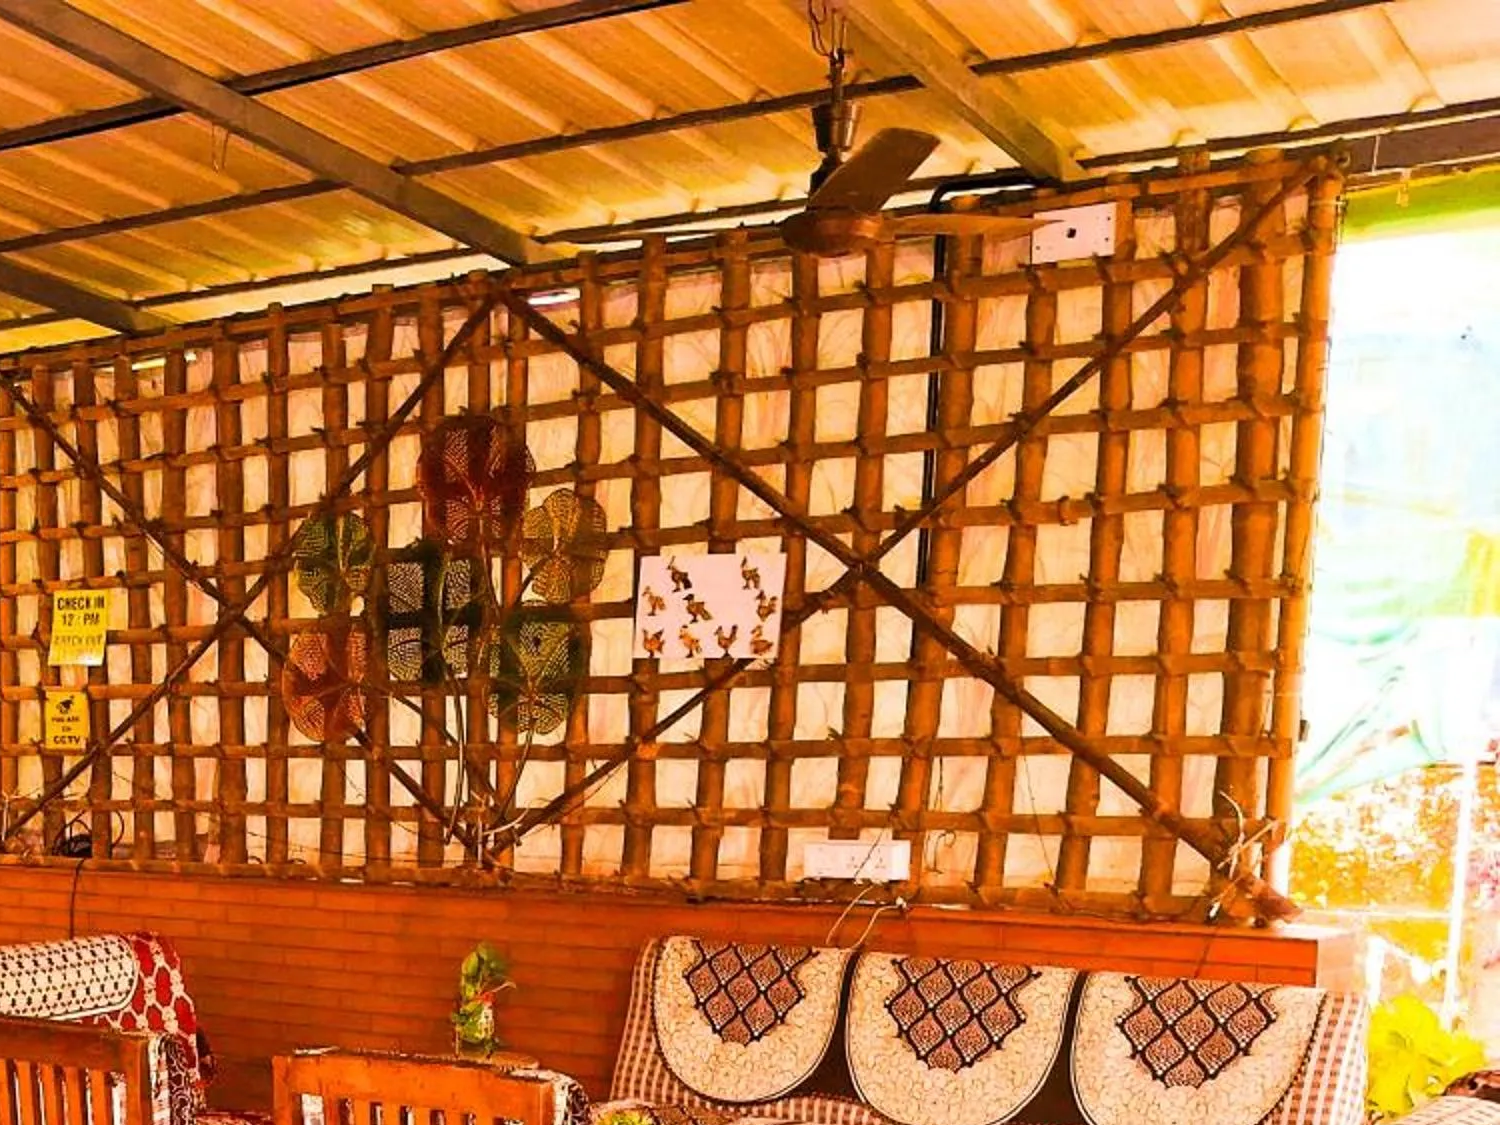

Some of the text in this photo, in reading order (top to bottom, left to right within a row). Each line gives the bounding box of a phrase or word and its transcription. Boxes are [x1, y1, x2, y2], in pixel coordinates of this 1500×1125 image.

[57, 596, 91, 610] CHECK
[83, 612, 100, 625] PM
[53, 735, 81, 745] CCTV
